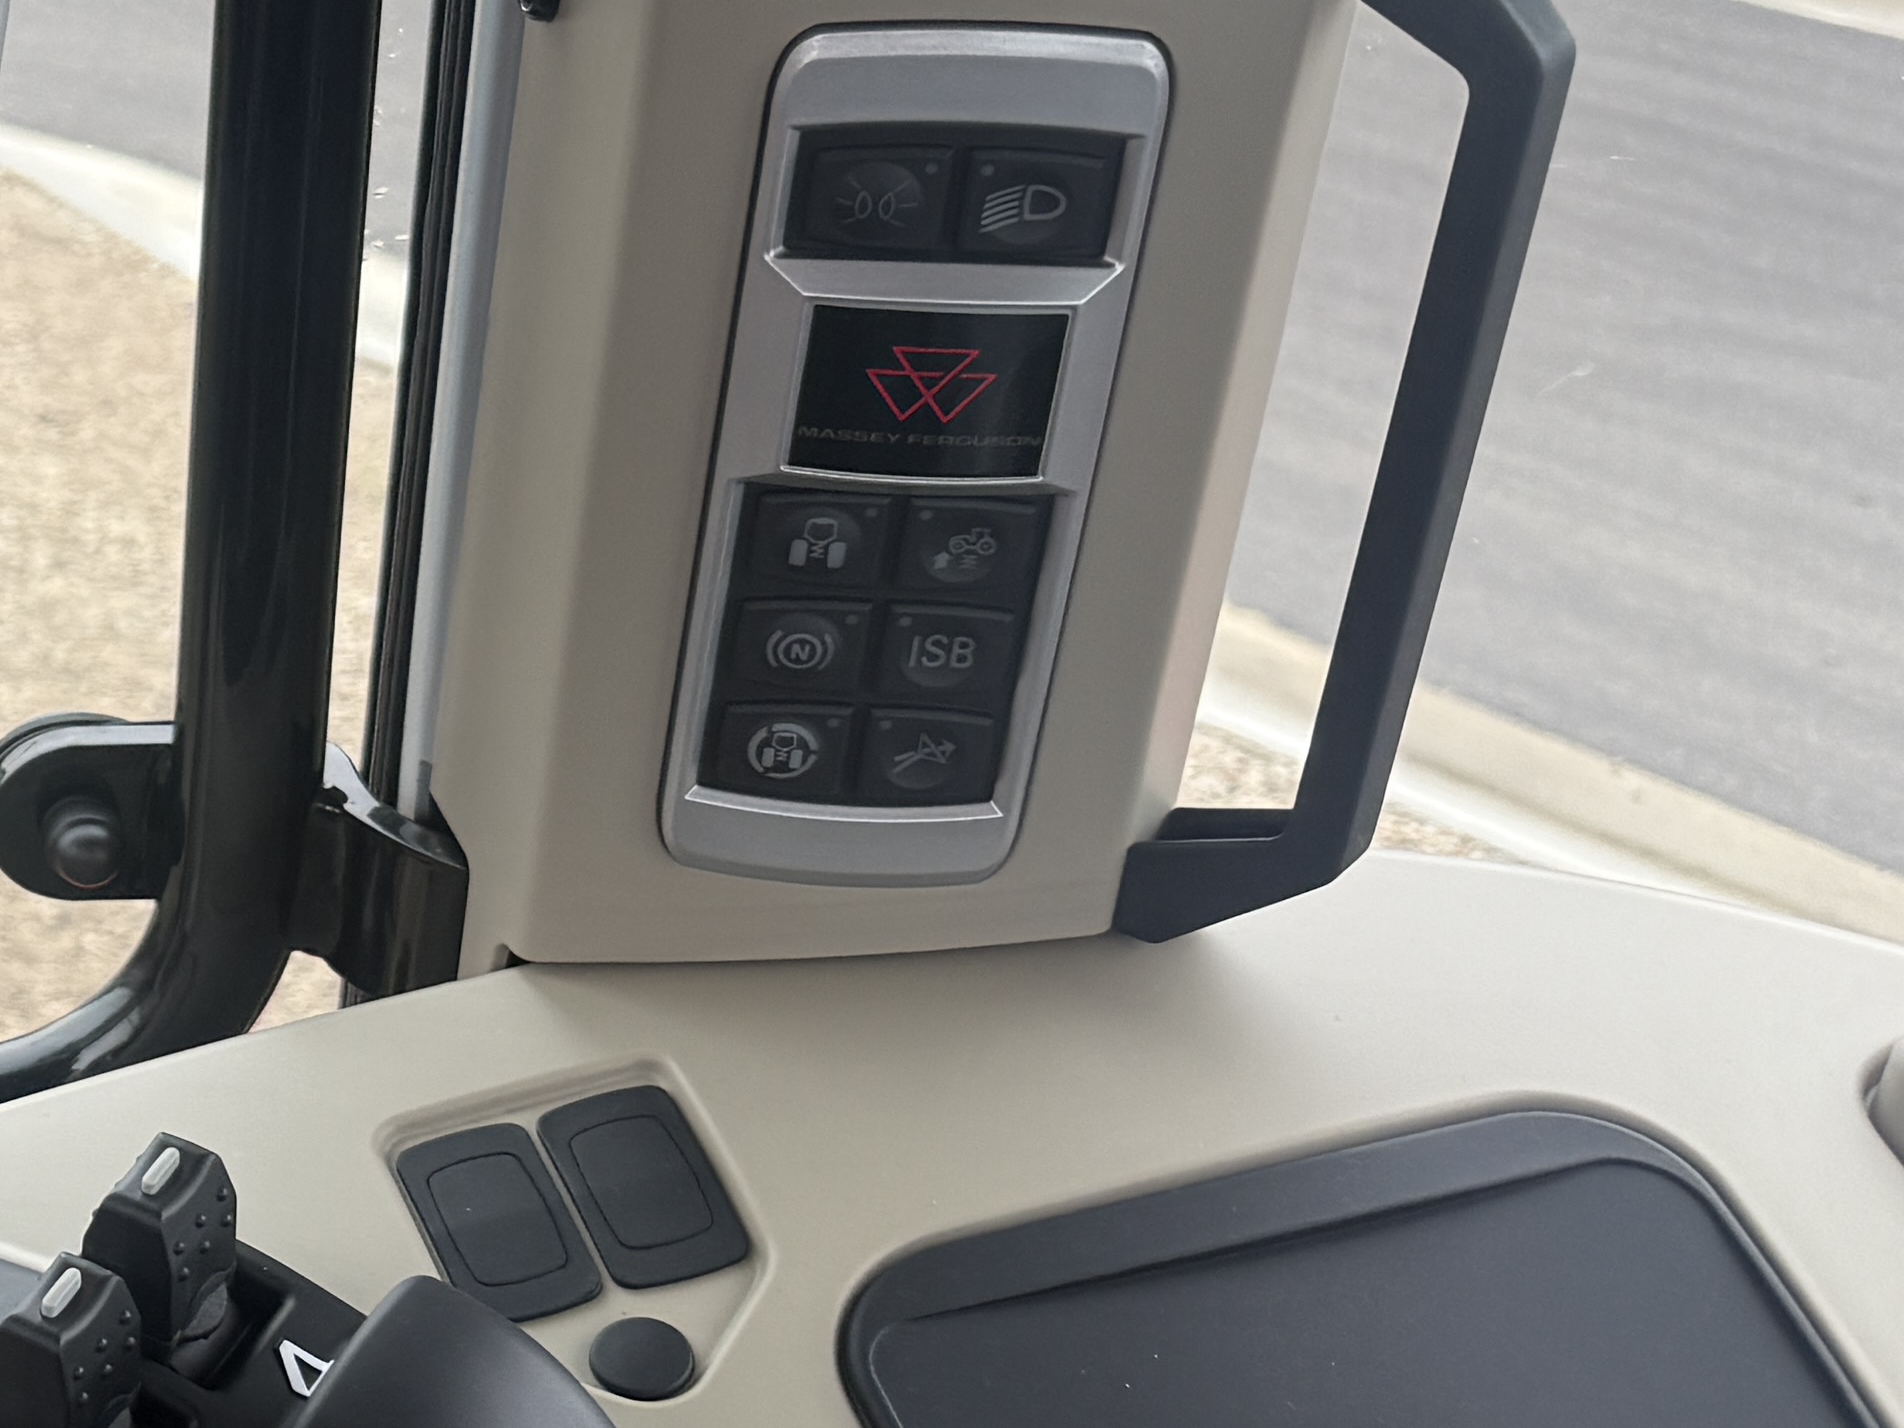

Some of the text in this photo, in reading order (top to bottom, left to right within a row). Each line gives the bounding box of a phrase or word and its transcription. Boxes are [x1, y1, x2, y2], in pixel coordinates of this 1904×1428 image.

[798, 426, 1042, 447] MASSEY FERGUSON
[791, 643, 811, 661] N
[908, 634, 976, 669] ISB
